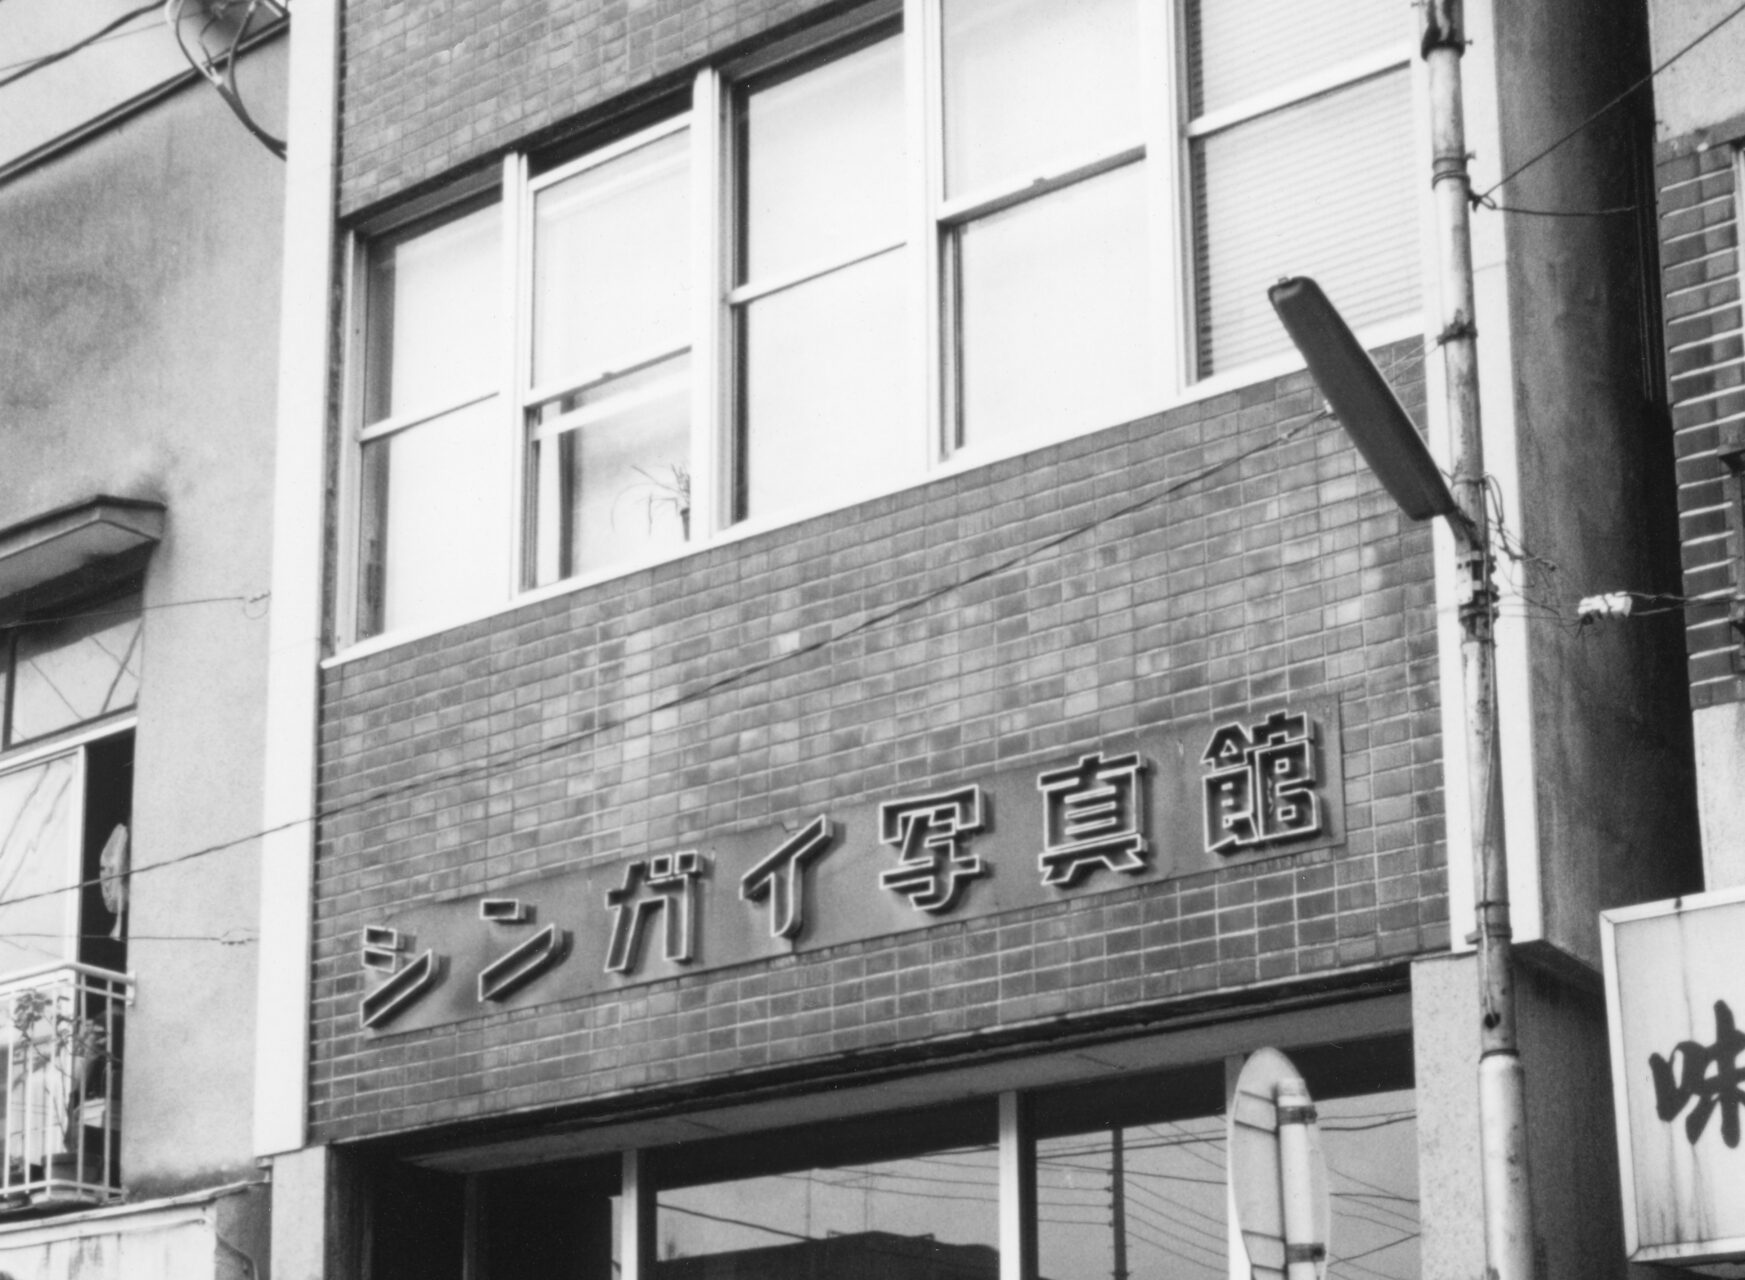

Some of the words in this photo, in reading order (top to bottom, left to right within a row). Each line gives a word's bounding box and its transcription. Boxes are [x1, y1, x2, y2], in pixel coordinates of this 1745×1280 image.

[360, 712, 1320, 1026] シンガイ写真館
